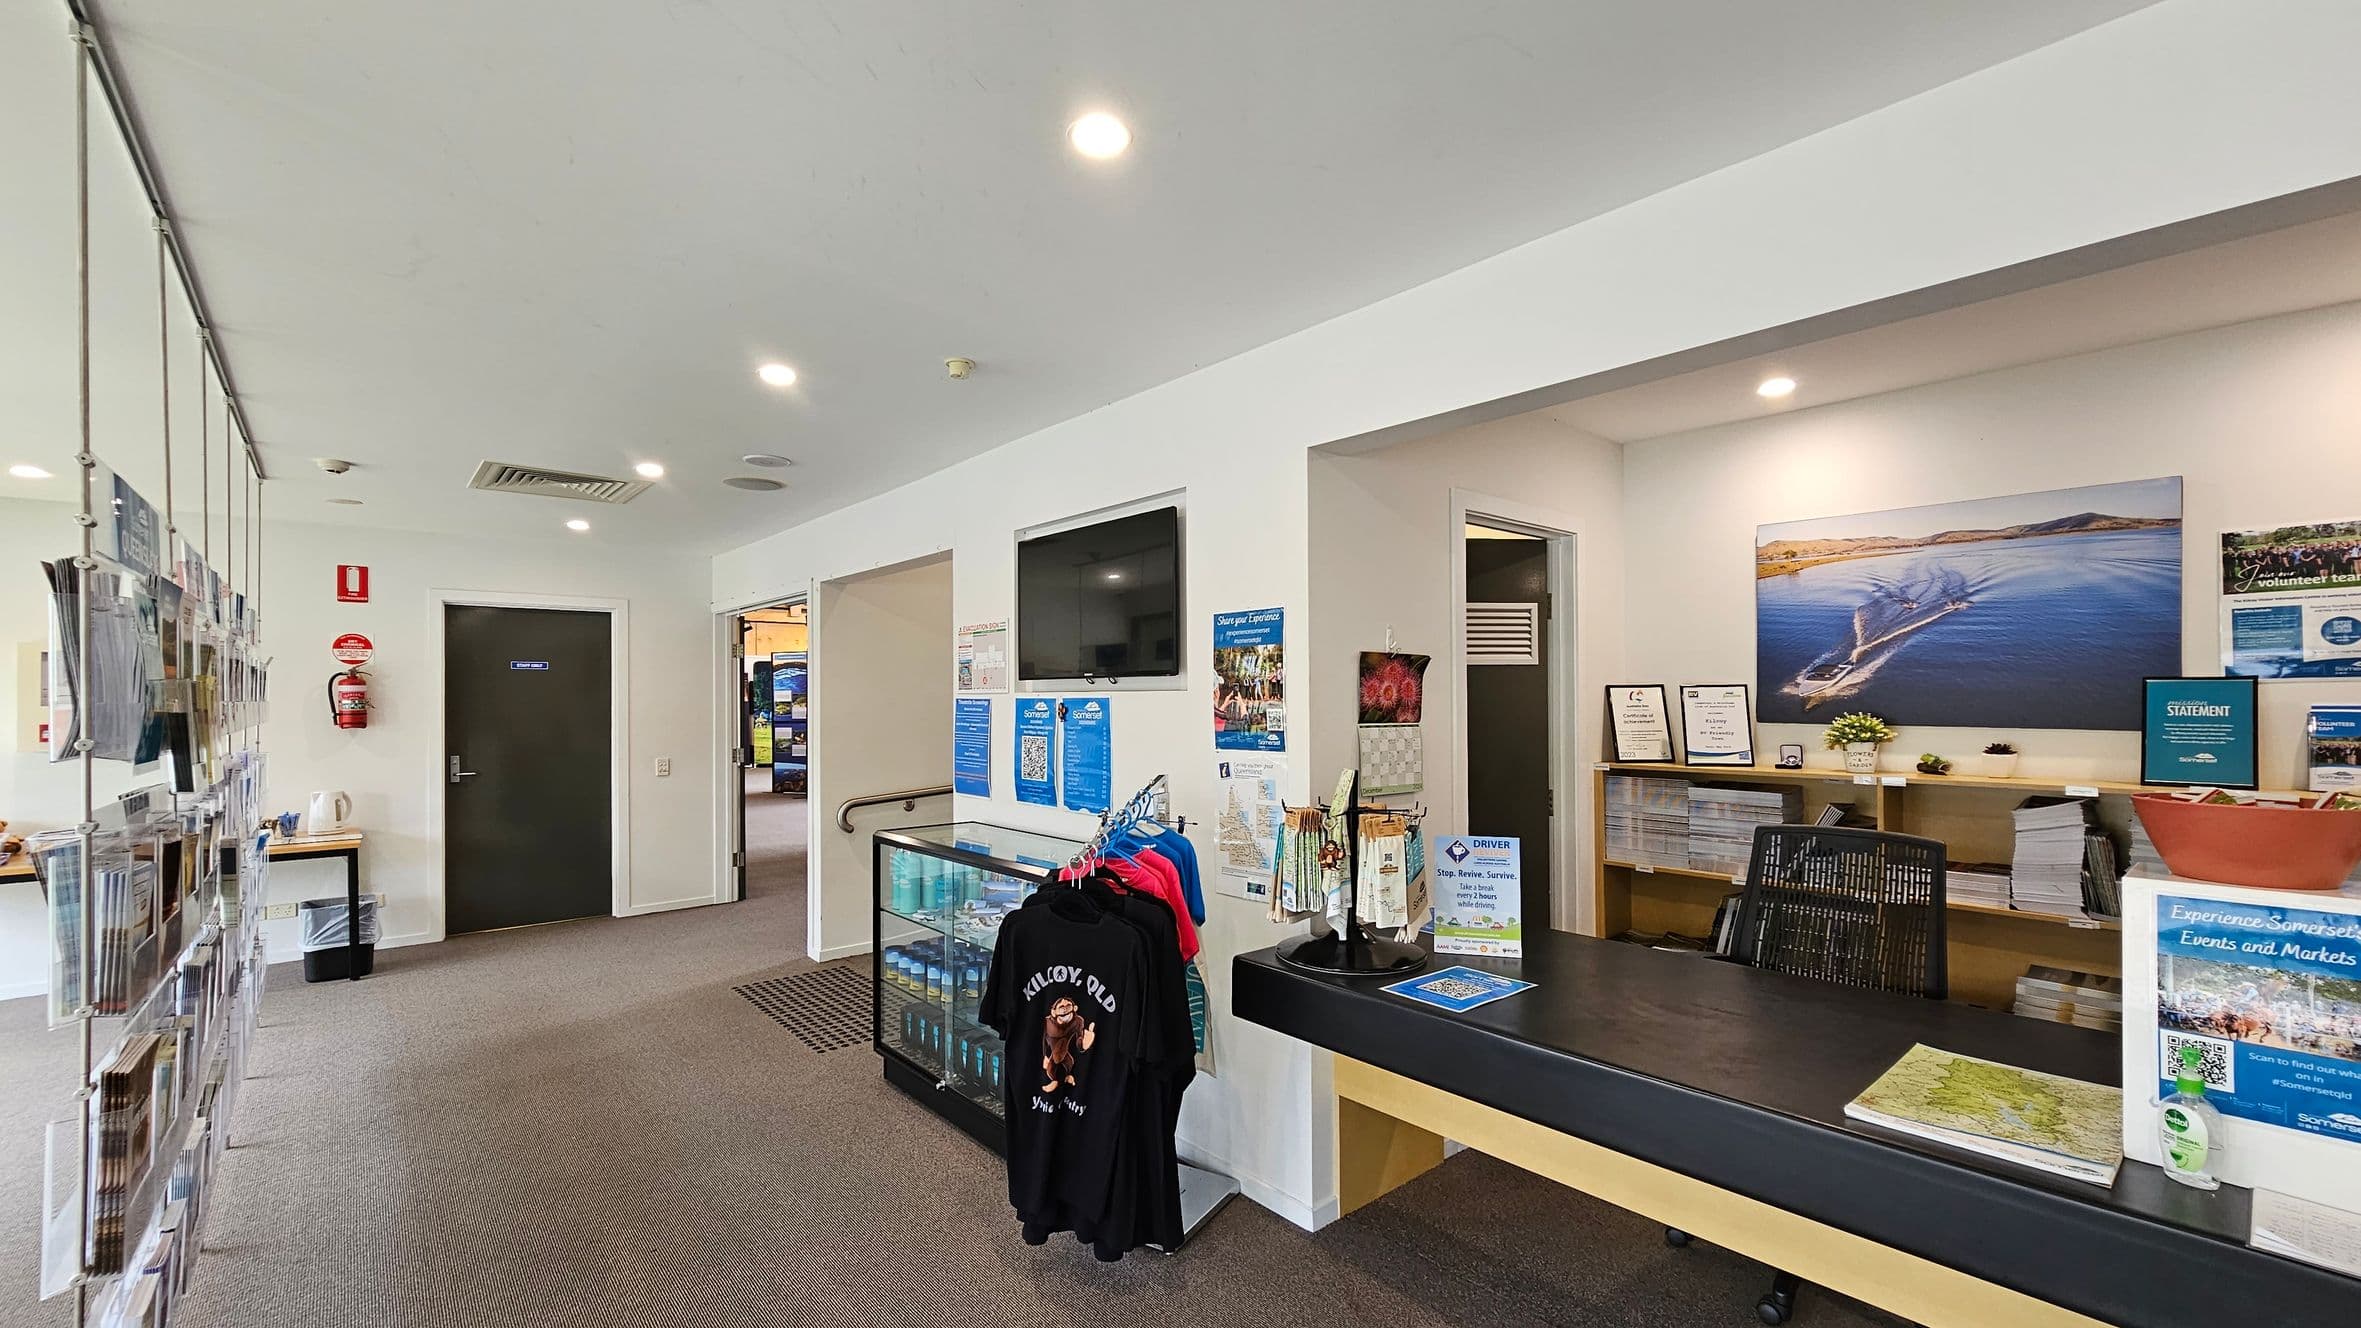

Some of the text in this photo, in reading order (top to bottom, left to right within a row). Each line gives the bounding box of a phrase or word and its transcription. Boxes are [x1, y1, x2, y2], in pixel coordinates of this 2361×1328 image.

[2258, 575, 2328, 588] volunteer
[1217, 612, 1280, 627] Share your Experience
[1024, 710, 1050, 718] Somerset
[1072, 710, 1102, 720] Somerset
[2167, 706, 2232, 716] STATEMENT
[1474, 840, 1510, 849] DRIVER
[1438, 868, 1517, 880] Stop. Revive. Survive.
[1479, 892, 1497, 900] hours
[2170, 904, 2361, 939] Experience Somerset's
[2180, 930, 2357, 966] Events and Markets
[1022, 965, 1118, 1013] KILCOY, QLD
[2248, 1052, 2274, 1064] Scan
[2292, 1060, 2314, 1070] find
[2316, 1066, 2336, 1075] out
[2314, 1075, 2324, 1083] in
[2272, 1078, 2352, 1100] #Somersetqld
[2165, 1114, 2188, 1128] Dettol
